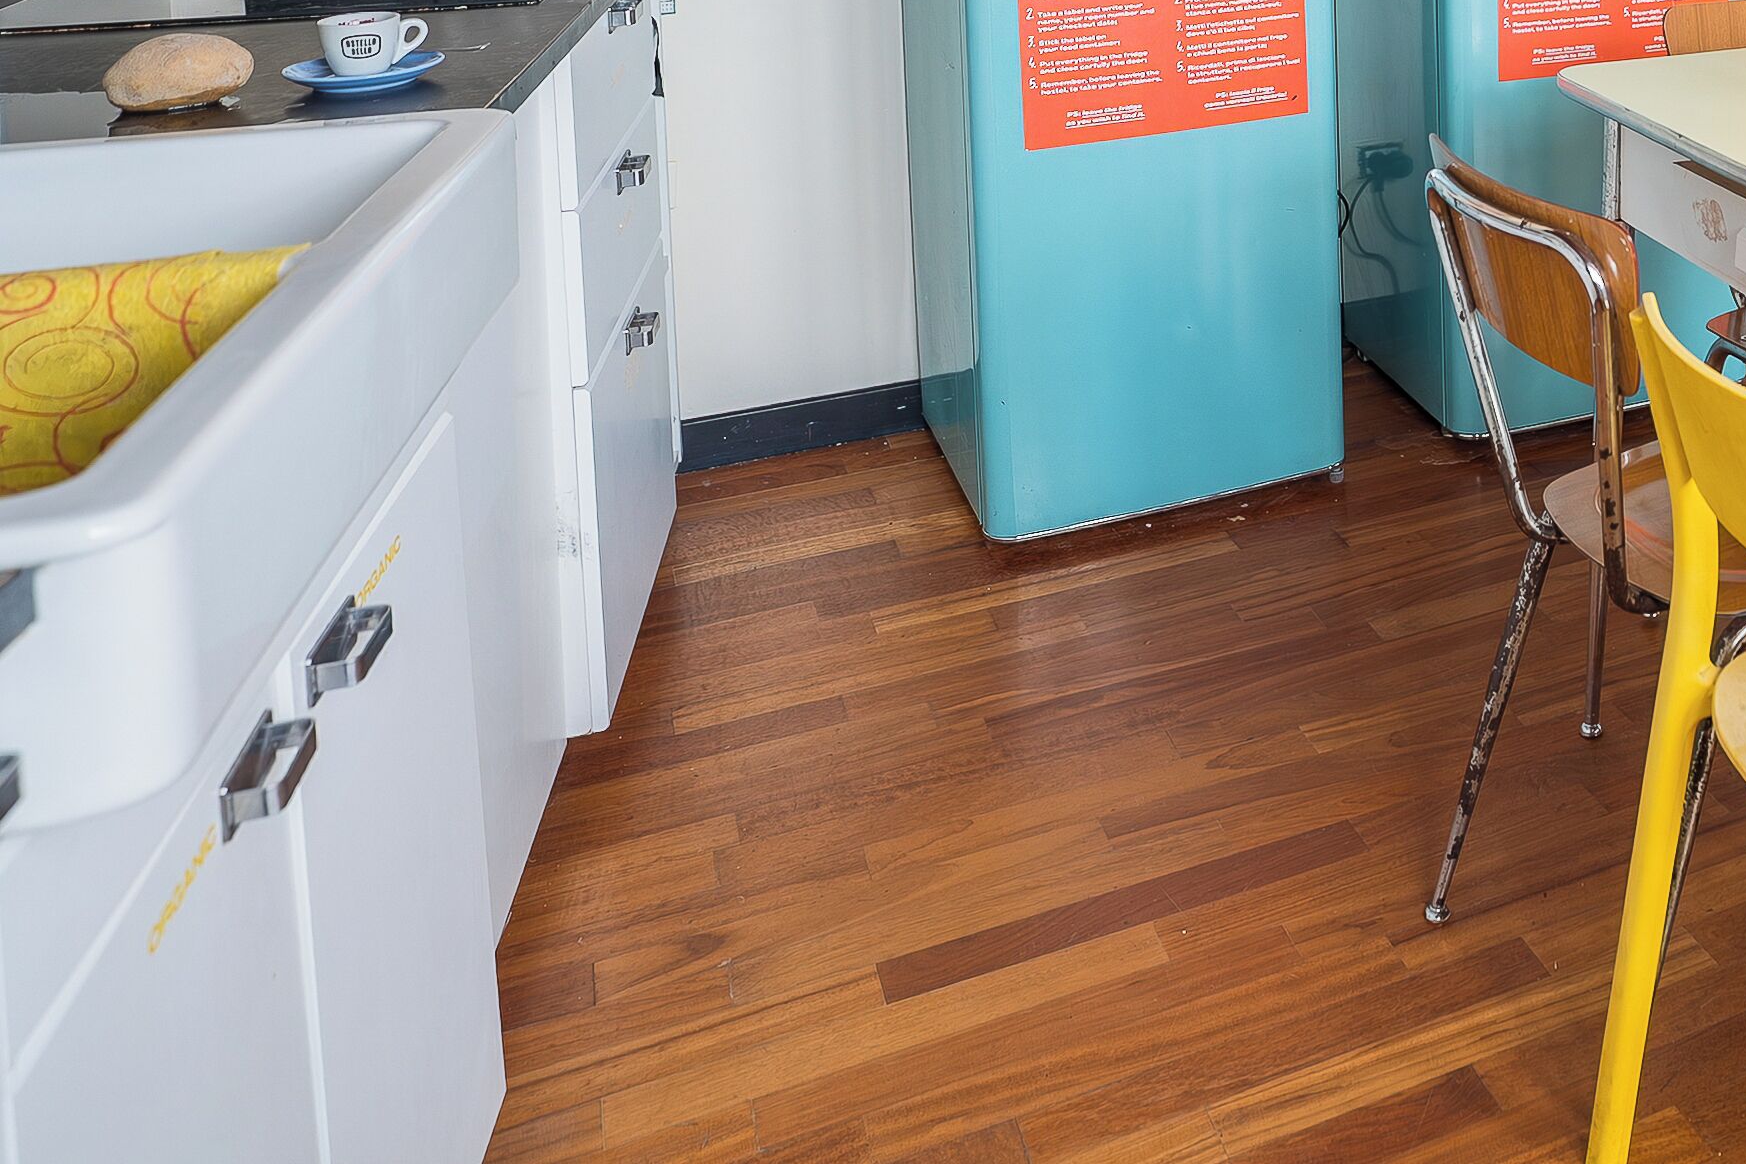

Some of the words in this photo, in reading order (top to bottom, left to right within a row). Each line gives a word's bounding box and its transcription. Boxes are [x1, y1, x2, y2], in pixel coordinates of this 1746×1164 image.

[1064, 8, 1085, 16] label
[1124, 3, 1143, 12] your
[1037, 26, 1058, 34] your
[1058, 21, 1096, 31] checkout
[346, 38, 376, 48] OSTELLO
[1038, 39, 1060, 47] Stick
[1075, 35, 1095, 43] label
[1038, 46, 1058, 54] your
[1060, 44, 1079, 52] food
[1040, 60, 1054, 68] Put
[1055, 56, 1100, 66] everything
[1123, 50, 1149, 59] fridge
[1040, 67, 1056, 75] and
[1056, 65, 1079, 73] close
[1029, 77, 1038, 89] 5.
[1089, 74, 1116, 83] before
[1117, 71, 1146, 80] leaving
[1080, 84, 1097, 92] take
[1098, 82, 1117, 90] your
[355, 534, 400, 608] ORGANIC
[148, 822, 216, 955] ORGANIC
